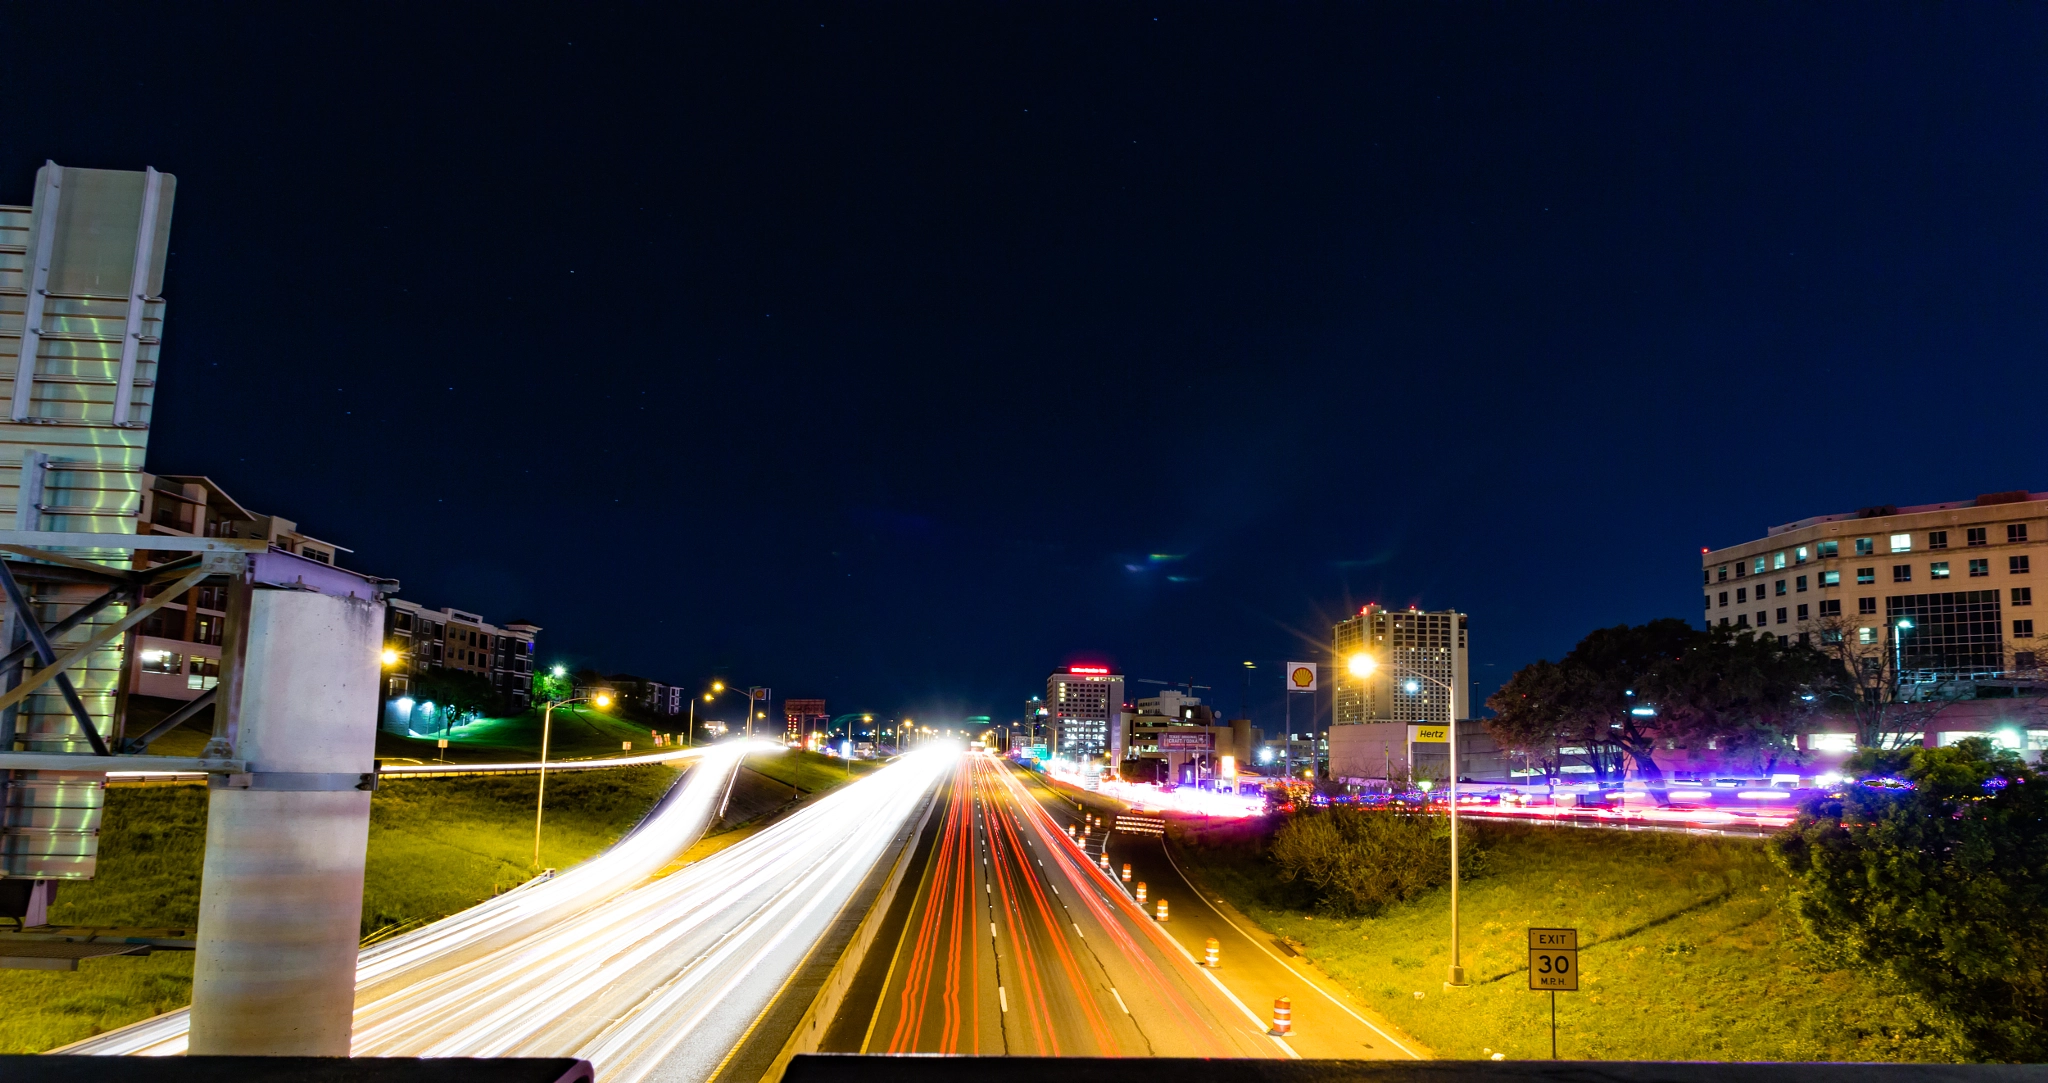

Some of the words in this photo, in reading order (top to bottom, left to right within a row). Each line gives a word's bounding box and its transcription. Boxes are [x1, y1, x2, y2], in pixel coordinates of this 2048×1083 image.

[1420, 730, 1444, 738] Hertz
[1540, 934, 1566, 944] EXIT
[1538, 955, 1569, 974] 30
